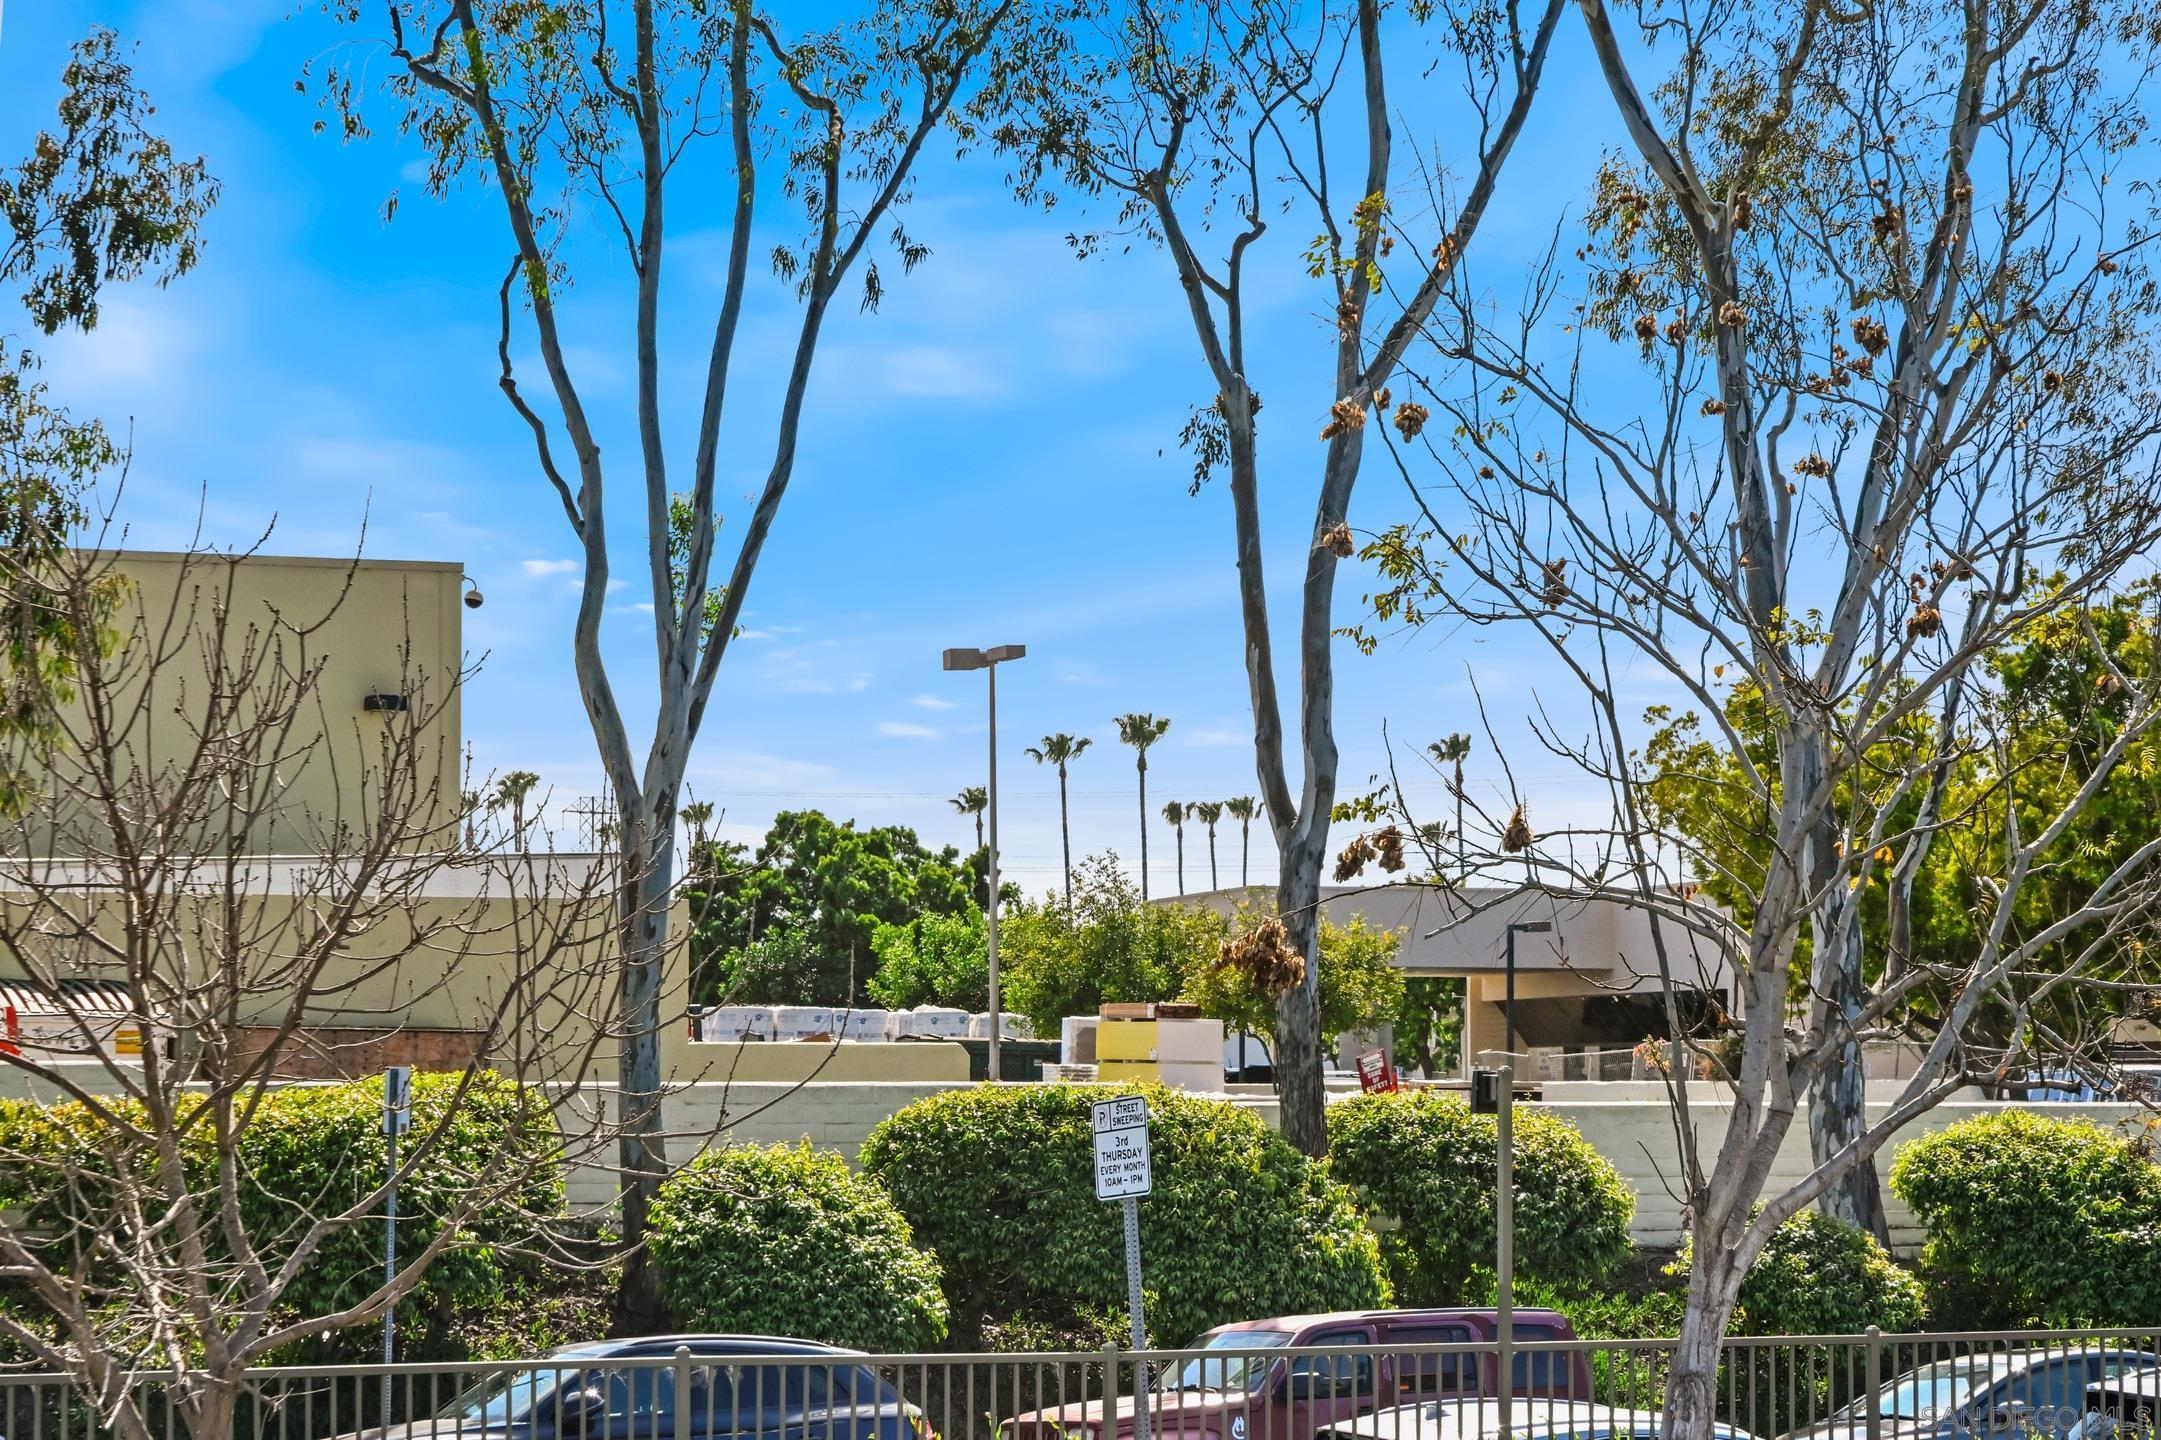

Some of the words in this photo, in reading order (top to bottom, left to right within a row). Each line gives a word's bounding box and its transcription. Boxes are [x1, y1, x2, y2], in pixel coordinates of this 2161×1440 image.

[1115, 1103, 1138, 1114] STREET
[1112, 1113, 1144, 1126] SWEEPING
[1115, 1136, 1128, 1147] 3rd
[1101, 1147, 1143, 1162] THURSDAY
[1100, 1164, 1121, 1175] EVERY
[1123, 1161, 1145, 1172] MONTH
